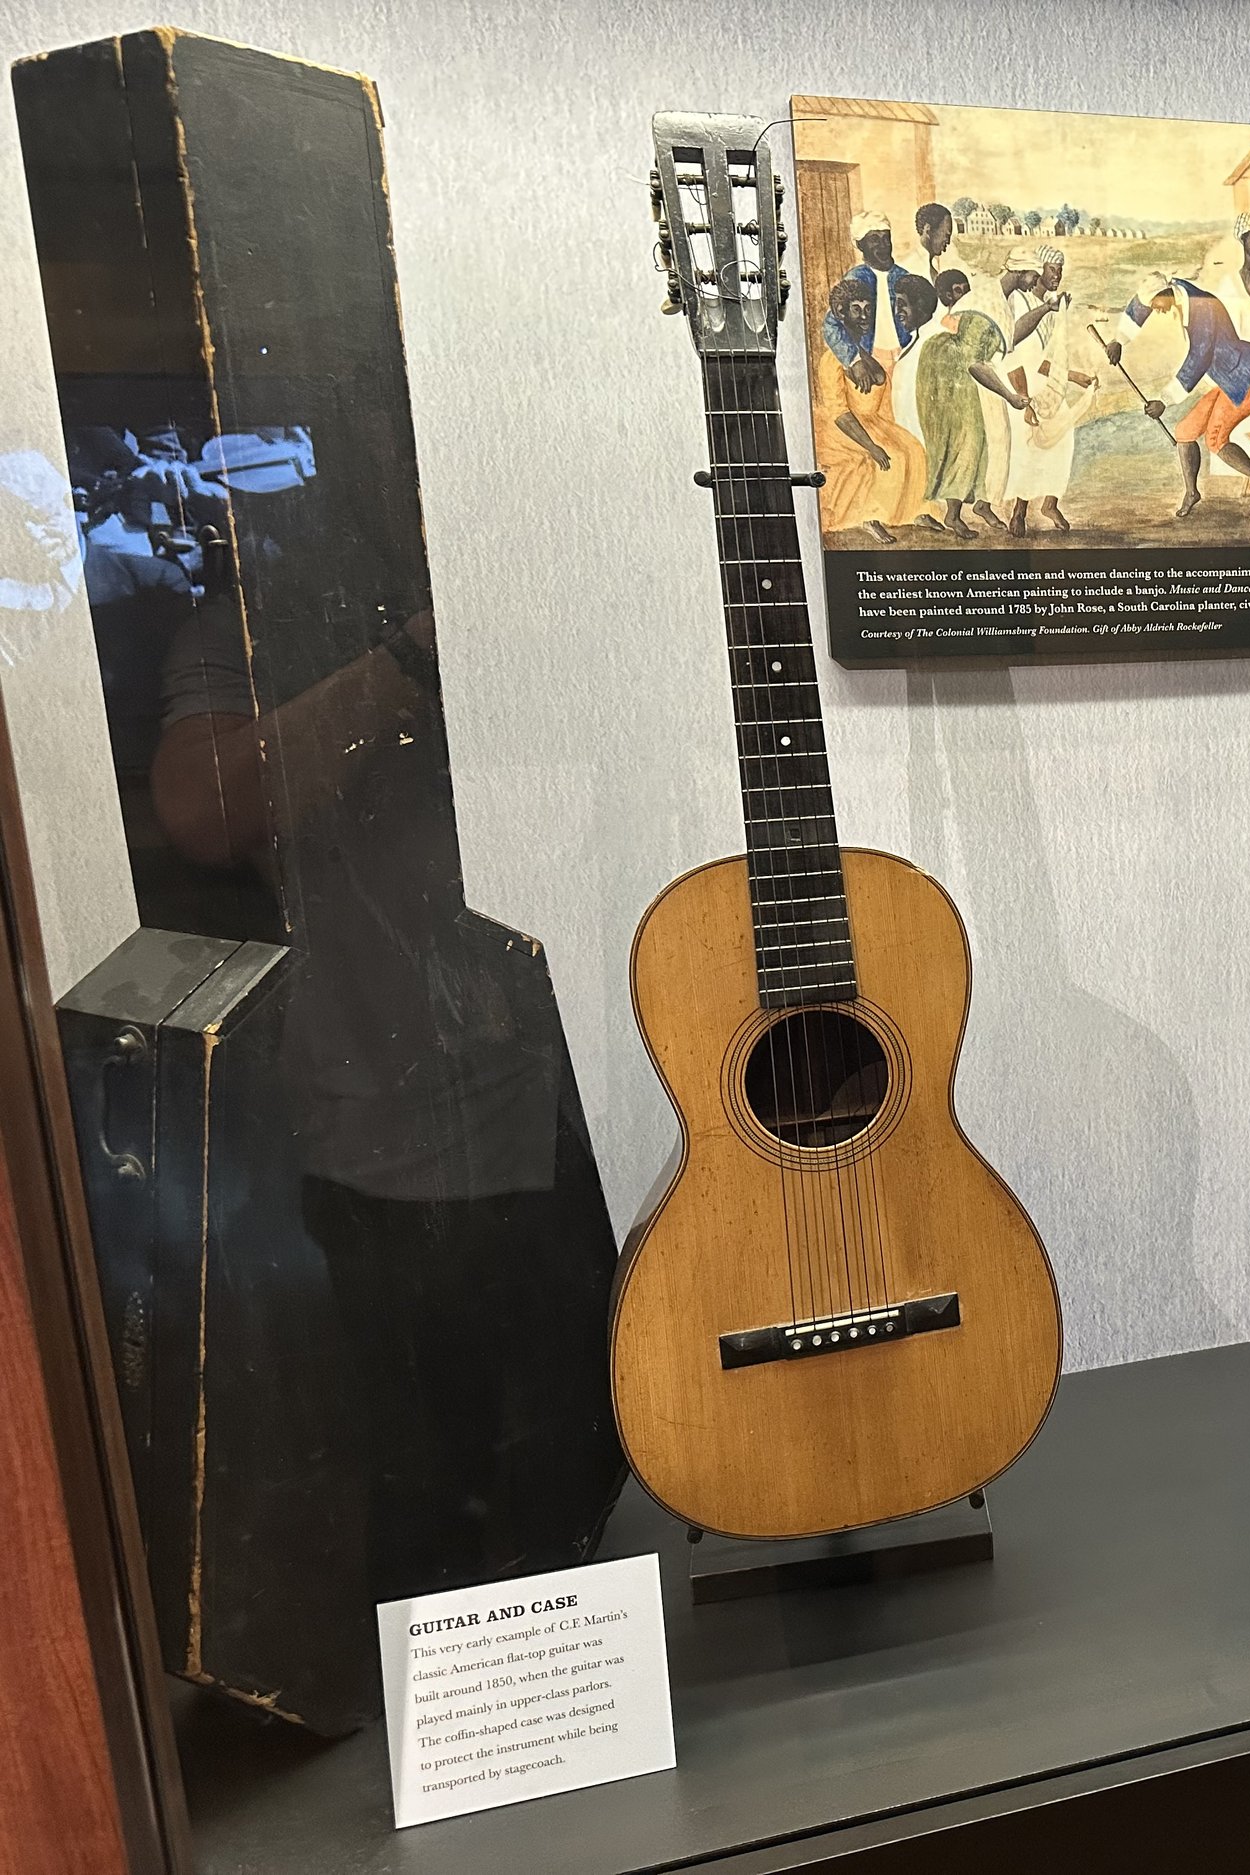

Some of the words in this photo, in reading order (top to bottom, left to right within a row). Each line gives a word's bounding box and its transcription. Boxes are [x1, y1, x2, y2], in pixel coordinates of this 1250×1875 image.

[855, 570, 883, 581] This
[885, 570, 948, 581] watercolor
[950, 570, 963, 580] of
[965, 569, 1014, 580] enslaved
[1044, 569, 1065, 579] and
[1067, 571, 1107, 579] women
[1109, 567, 1151, 581] dancing
[1153, 570, 1164, 578] to
[1166, 567, 1183, 577] the
[857, 589, 876, 599] the
[879, 588, 923, 599] earliest
[924, 588, 963, 598] known
[965, 587, 1020, 597] American
[1022, 585, 1068, 599] painting
[1070, 587, 1082, 596] to
[1084, 585, 1123, 595] include
[1125, 587, 1133, 595] a
[1134, 584, 1166, 596] banjo.
[1168, 583, 1200, 594] Music
[1202, 583, 1222, 593] and
[858, 606, 886, 616] have
[888, 605, 916, 616] been
[918, 604, 962, 618] painted
[965, 604, 1005, 615] around
[1008, 603, 1031, 614] 1785
[1033, 603, 1049, 616] by
[1048, 602, 1074, 616] John
[1076, 602, 1106, 614] Rose,
[1108, 604, 1115, 612] a
[1117, 601, 1148, 612] South
[1150, 600, 1195, 611] Carolina
[1197, 599, 1236, 612] planter,
[860, 629, 902, 640] Courtesy
[904, 628, 915, 639] of
[916, 628, 933, 637] The
[935, 627, 974, 636] Colonial
[976, 626, 1037, 636] Williamsburg
[1038, 624, 1089, 634] Foundation.
[1092, 624, 1108, 635] Gift
[1110, 623, 1120, 634] of
[1119, 623, 1142, 634] Abby
[1142, 622, 1174, 631] Aldrich
[1176, 621, 1222, 632] Rockefeller
[408, 1613, 481, 1636] GUITAR
[485, 1604, 525, 1622] AND
[530, 1594, 577, 1613] CASE
[410, 1645, 436, 1659] This
[439, 1642, 463, 1653] very
[465, 1635, 493, 1648] early
[495, 1625, 541, 1643] example
[543, 1621, 556, 1634] of
[583, 1609, 627, 1626] Martin's
[412, 1666, 447, 1681] classic
[449, 1657, 504, 1674] American
[506, 1649, 546, 1663] flat-top
[548, 1642, 580, 1658] guitar
[582, 1638, 603, 1648] was
[414, 1689, 440, 1704] built
[442, 1680, 482, 1698] around
[486, 1675, 516, 1689] 1850,
[518, 1671, 548, 1683] when
[550, 1665, 568, 1677] the
[570, 1659, 602, 1676] guitar
[604, 1656, 624, 1666] was
[416, 1708, 452, 1729] played
[455, 1702, 493, 1718] mainly
[495, 1699, 507, 1710] in
[509, 1688, 569, 1709] upper-class
[571, 1680, 611, 1698] parlors.
[417, 1735, 441, 1748] The
[444, 1718, 518, 1743] coffin-shaped
[520, 1716, 543, 1727] case
[545, 1711, 566, 1721] was
[568, 1698, 615, 1717] designed
[420, 1762, 431, 1770] to
[434, 1752, 473, 1771] protect
[476, 1747, 494, 1758] the
[496, 1735, 555, 1754] instrument
[557, 1727, 586, 1741] while
[588, 1722, 618, 1735] being
[422, 1769, 485, 1792] transported
[487, 1768, 501, 1780] by
[504, 1754, 565, 1775] stagecoach.
